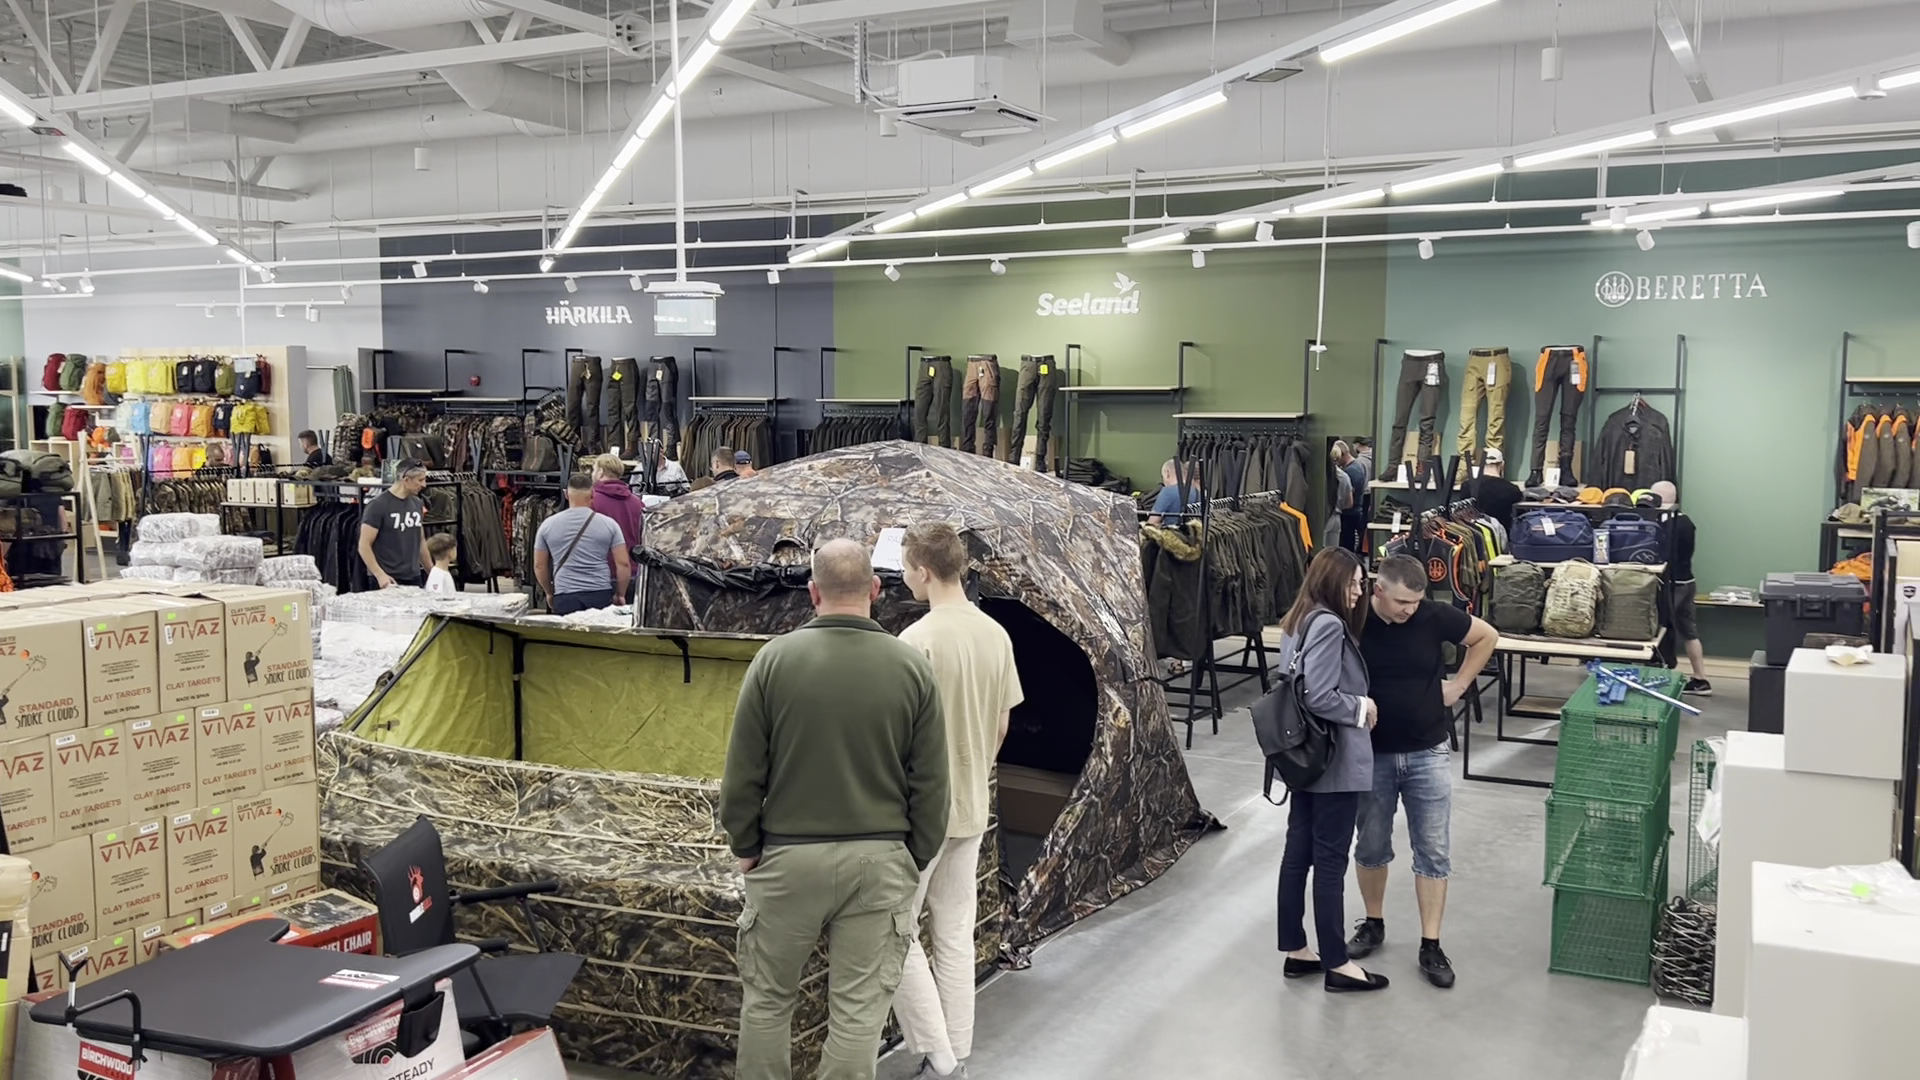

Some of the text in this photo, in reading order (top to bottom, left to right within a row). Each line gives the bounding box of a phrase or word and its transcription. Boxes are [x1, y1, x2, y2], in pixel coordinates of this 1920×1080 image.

[1636, 273, 1768, 300] BERETTA
[545, 300, 633, 326] HÄRKILA
[1035, 290, 1141, 316] Seeland
[390, 511, 422, 532] 7,62
[231, 611, 266, 626] VIVAZ
[267, 659, 307, 673] STANDARD
[93, 686, 152, 703] CLAY TARGETS
[166, 676, 222, 691] CLAY TARGETS
[18, 697, 74, 714] STANDARD
[264, 701, 310, 724] VIVAZ
[15, 705, 80, 729] SMOKE CLOUDS
[201, 711, 255, 736] VIVAZ
[132, 723, 189, 750] VIVAZ
[57, 737, 119, 765] VIVAZ
[264, 754, 312, 772] CLAY TARGETS
[202, 768, 257, 786] CLAY TARGETS
[133, 782, 191, 801] CLAY TARGETS
[59, 799, 122, 819] CLAY TARGETS
[237, 803, 272, 821] VIVAZ
[174, 816, 227, 844] VIVAZ
[100, 832, 159, 862] VIVAZ
[272, 846, 313, 864] STANDARD
[174, 873, 229, 894] CLAY TARGETS
[102, 892, 161, 915] CLAY TARGETS
[32, 920, 89, 949] MOKE CLOUDS
[344, 930, 372, 953] CHAIR
